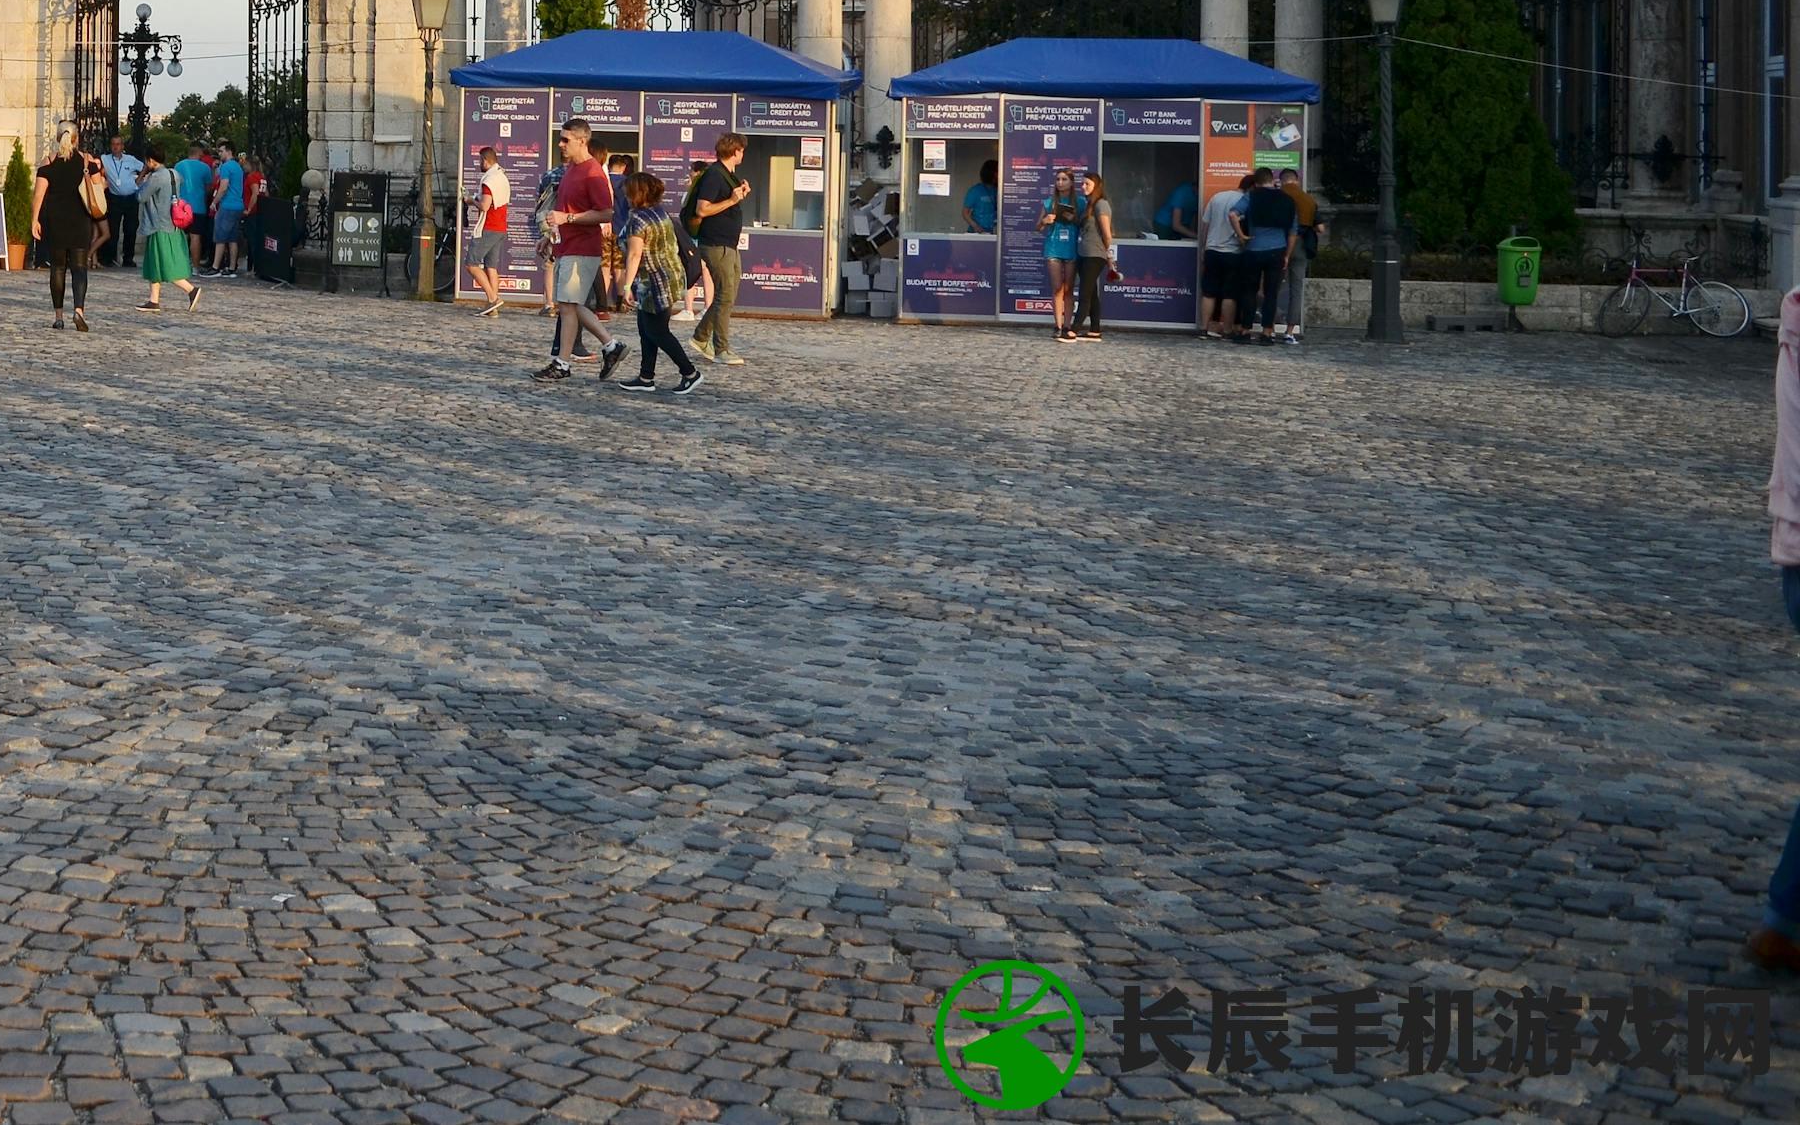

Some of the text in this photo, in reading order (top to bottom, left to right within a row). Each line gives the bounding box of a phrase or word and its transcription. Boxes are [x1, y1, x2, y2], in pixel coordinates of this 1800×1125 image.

[963, 104, 993, 112] PÉNZTÁR
[1063, 106, 1092, 114] PÉNZTÁR
[1025, 113, 1085, 122] PRE-PAID TICKETS
[1141, 117, 1155, 125] YOU
[1171, 118, 1192, 126] MOVE
[360, 249, 378, 262] WC
[740, 273, 769, 281] UDAPEST
[906, 278, 942, 286] BUDAPEST
[1103, 285, 1140, 293] BUDAPEST
[1025, 302, 1053, 310] SPA
